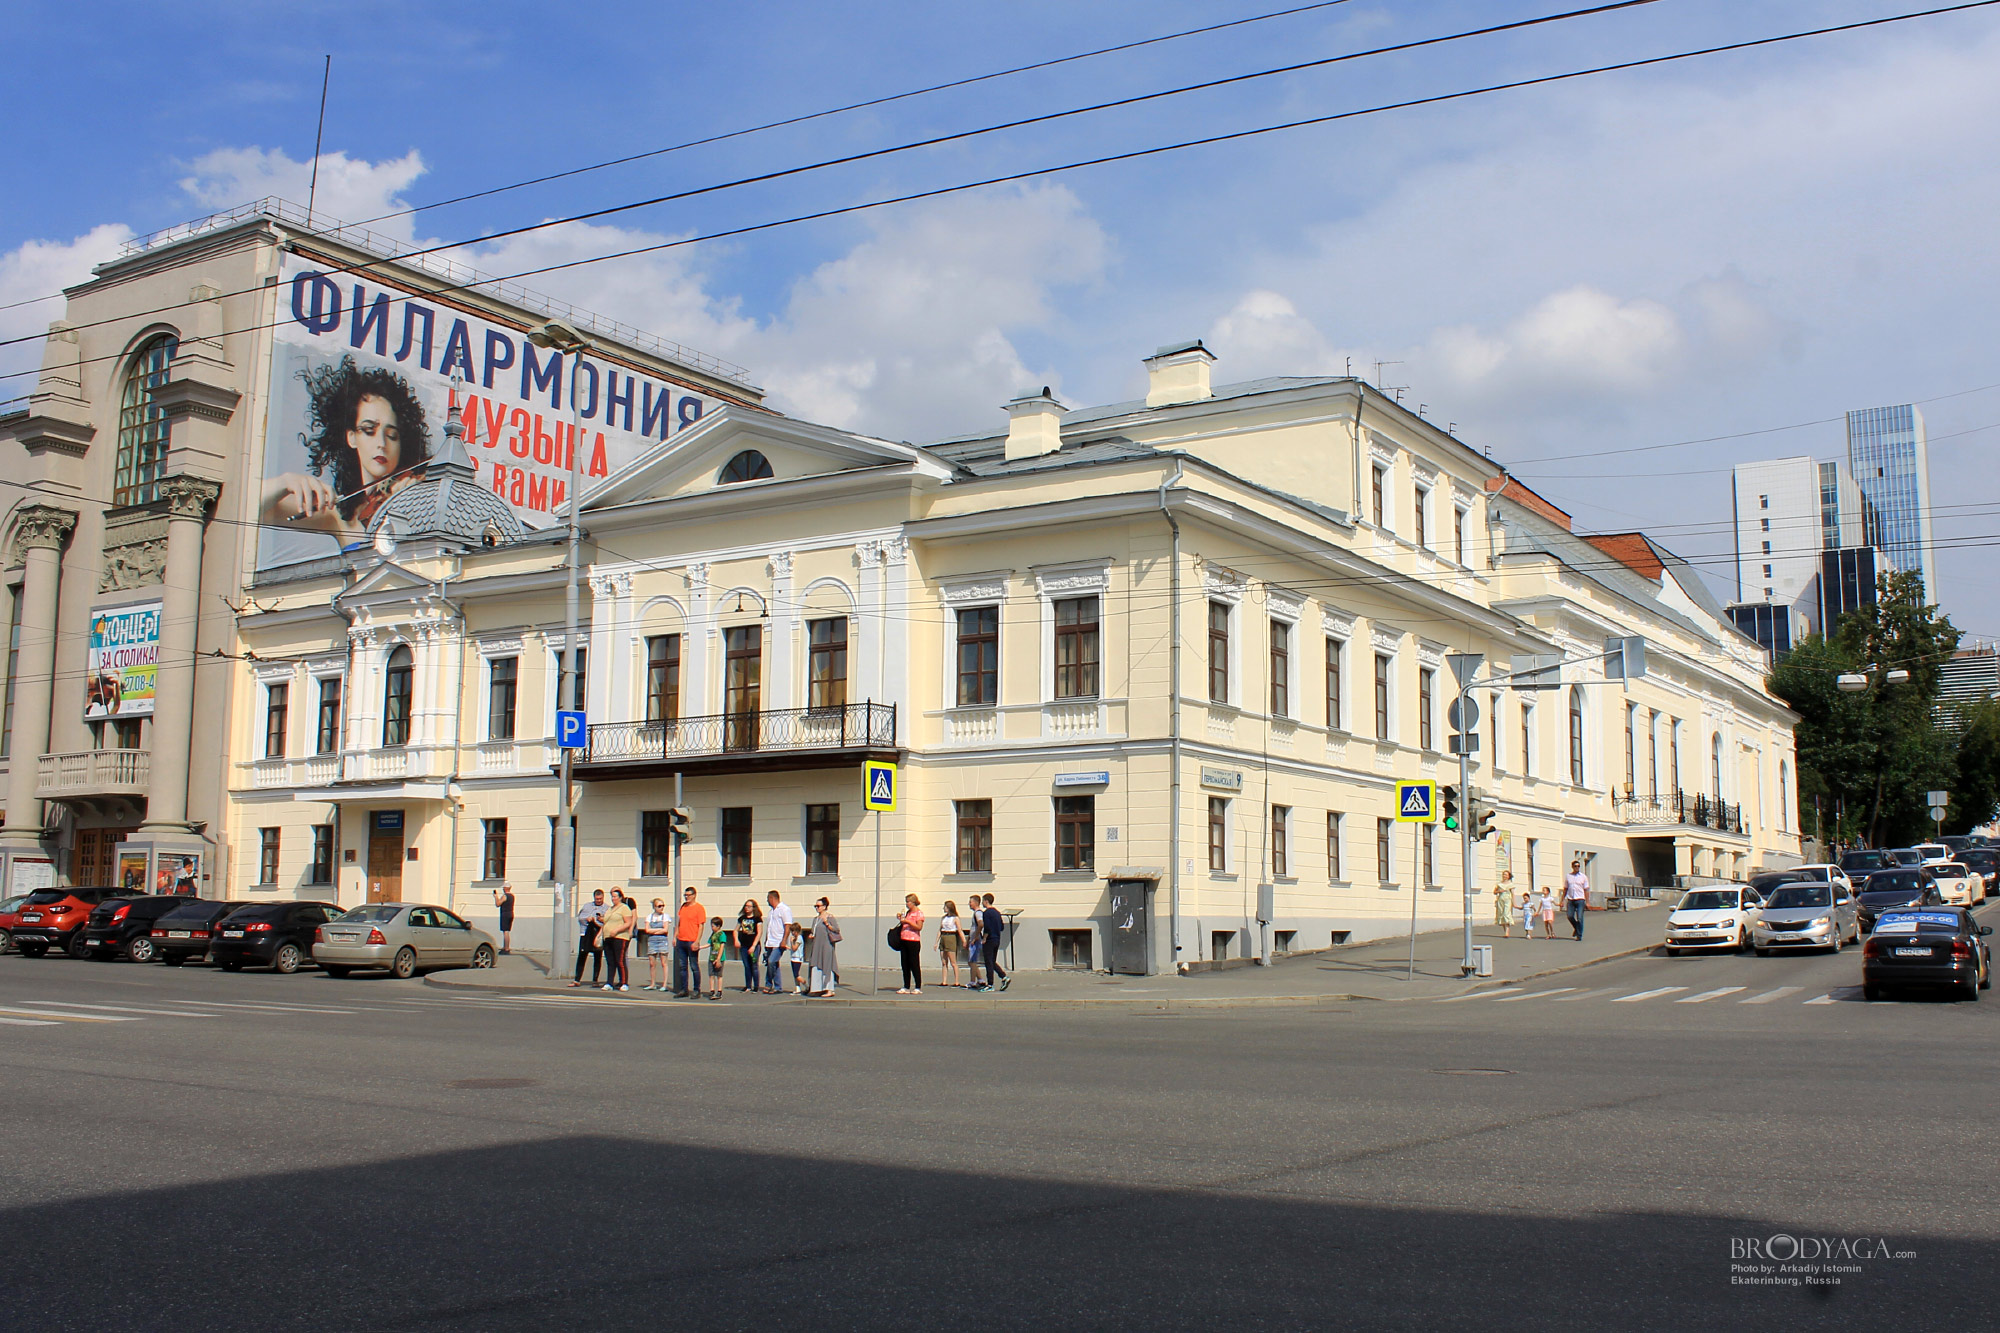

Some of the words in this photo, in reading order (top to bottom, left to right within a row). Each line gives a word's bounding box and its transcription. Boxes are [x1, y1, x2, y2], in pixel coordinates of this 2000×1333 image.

[292, 270, 703, 441] ФИЛАРМОНИЯ
[447, 388, 609, 478] МУЗЫКА
[102, 611, 161, 646] КОНЦЕРТ
[101, 651, 112, 669] ЗА
[1236, 773, 1242, 787] 9
